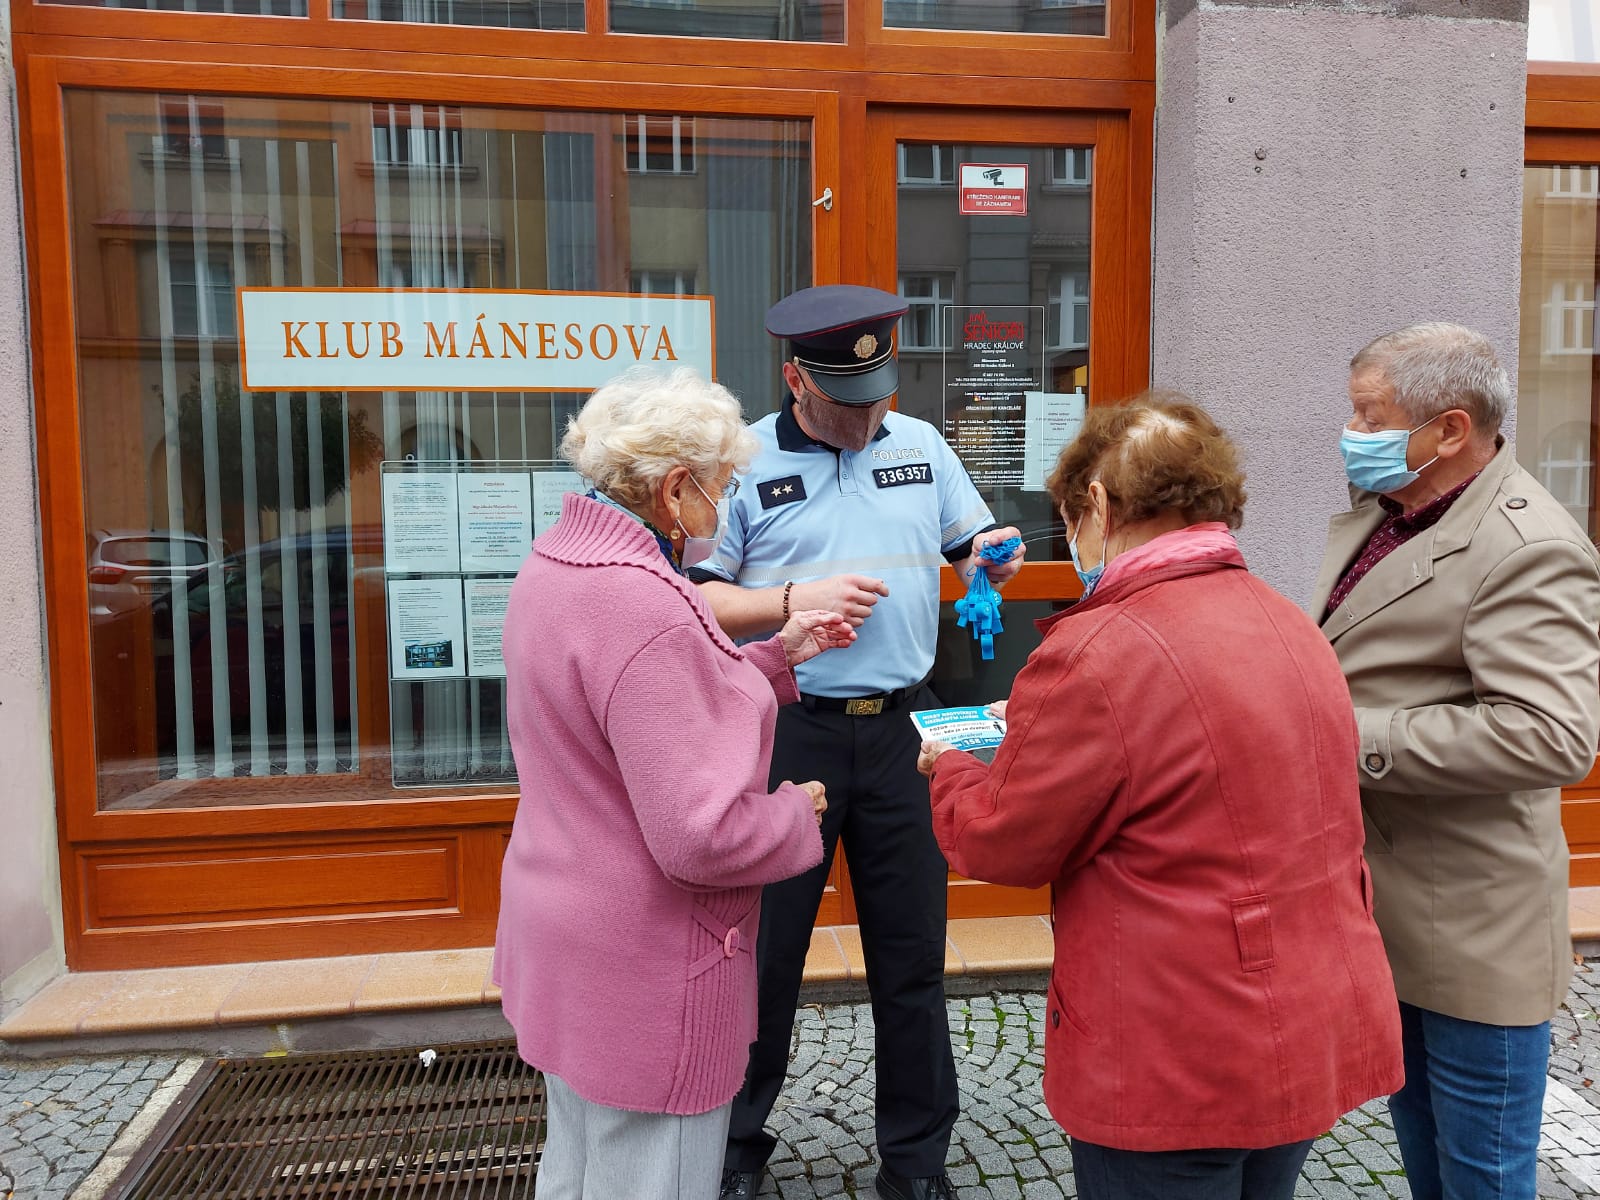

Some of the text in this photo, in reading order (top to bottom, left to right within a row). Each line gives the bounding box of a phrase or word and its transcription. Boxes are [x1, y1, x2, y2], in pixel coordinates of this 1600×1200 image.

[281, 313, 678, 361] KLUB MÁNESOVA
[963, 341, 1024, 350] HRADEC KRÁLOVÉ
[871, 448, 924, 461] POLICIE
[879, 466, 927, 484] 336357
